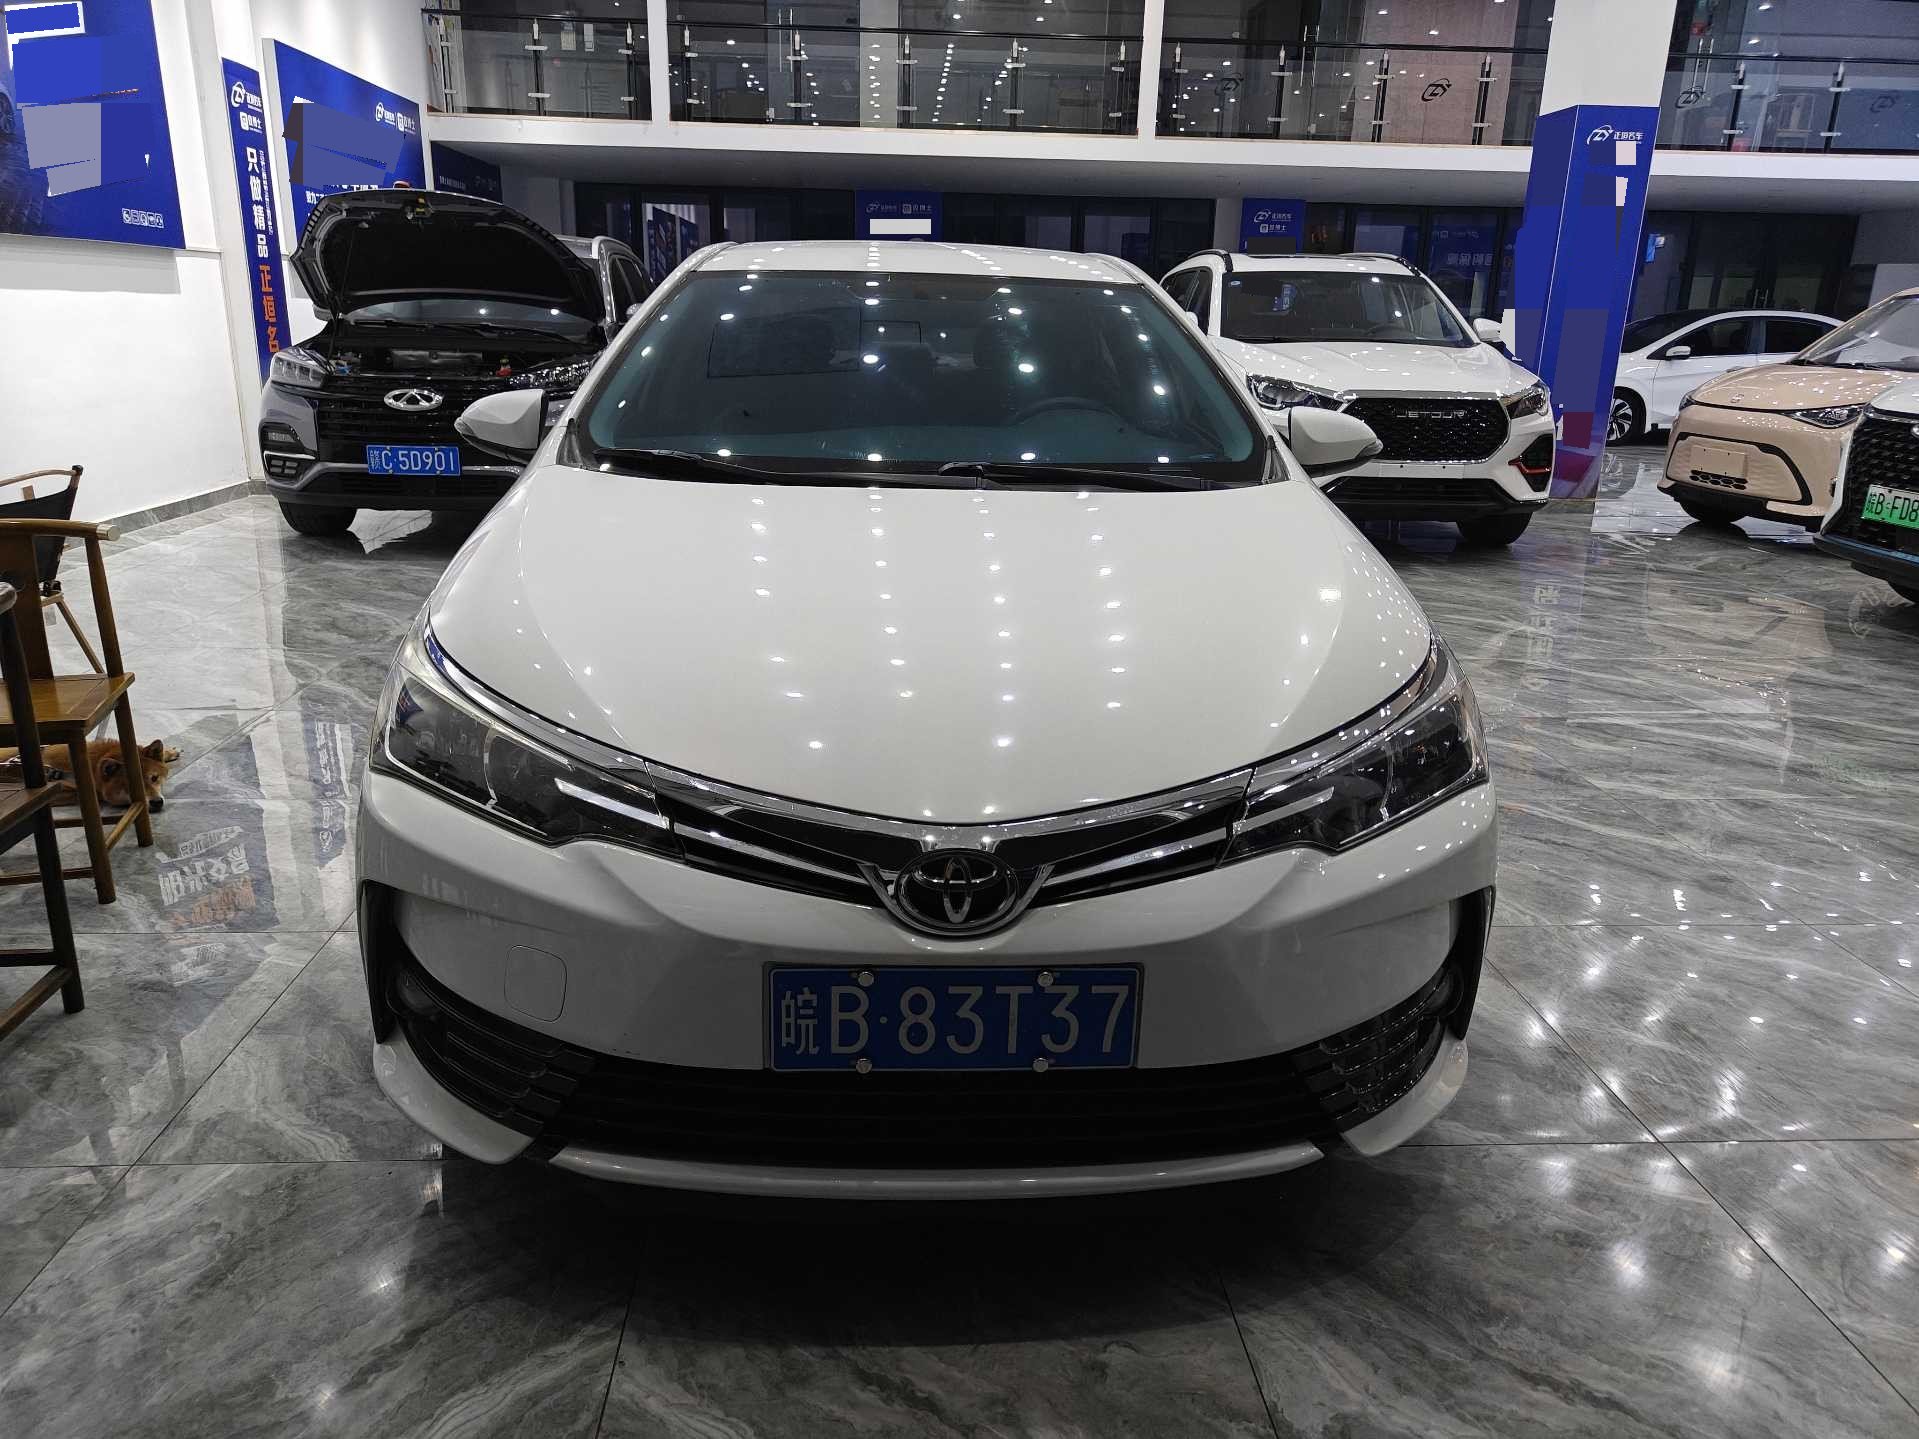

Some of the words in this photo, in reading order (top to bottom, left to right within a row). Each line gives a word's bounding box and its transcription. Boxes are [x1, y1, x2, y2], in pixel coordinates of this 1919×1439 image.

[246, 146, 269, 258] 只做精品
[781, 985, 1130, 1056] 皖B·83T37
